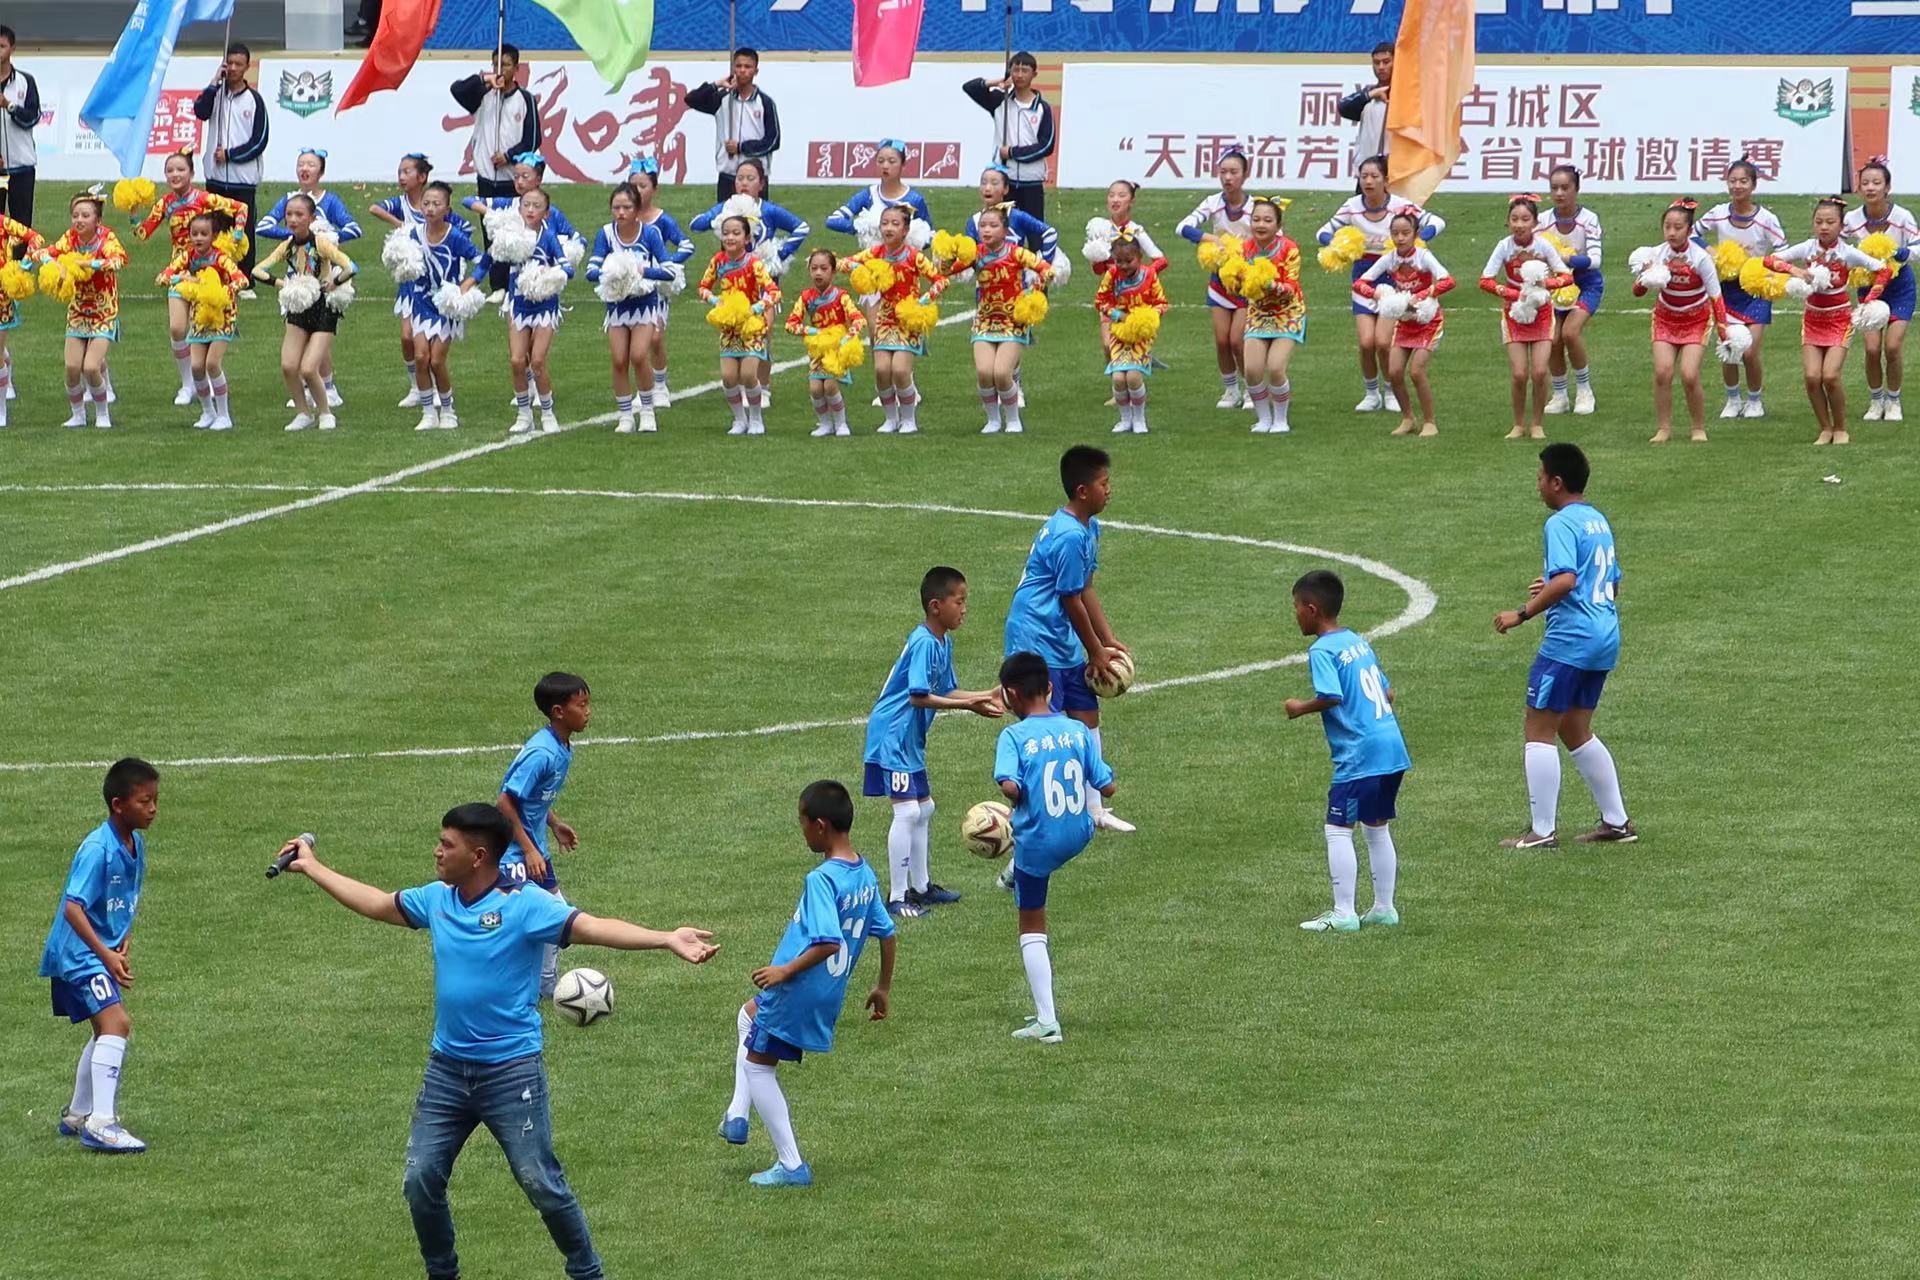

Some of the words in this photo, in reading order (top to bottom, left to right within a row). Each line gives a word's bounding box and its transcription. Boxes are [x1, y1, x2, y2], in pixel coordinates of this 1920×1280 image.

[891, 771, 910, 793] 89
[1043, 758, 1086, 819] 63
[506, 862, 527, 882] 79
[90, 973, 113, 1001] 67
